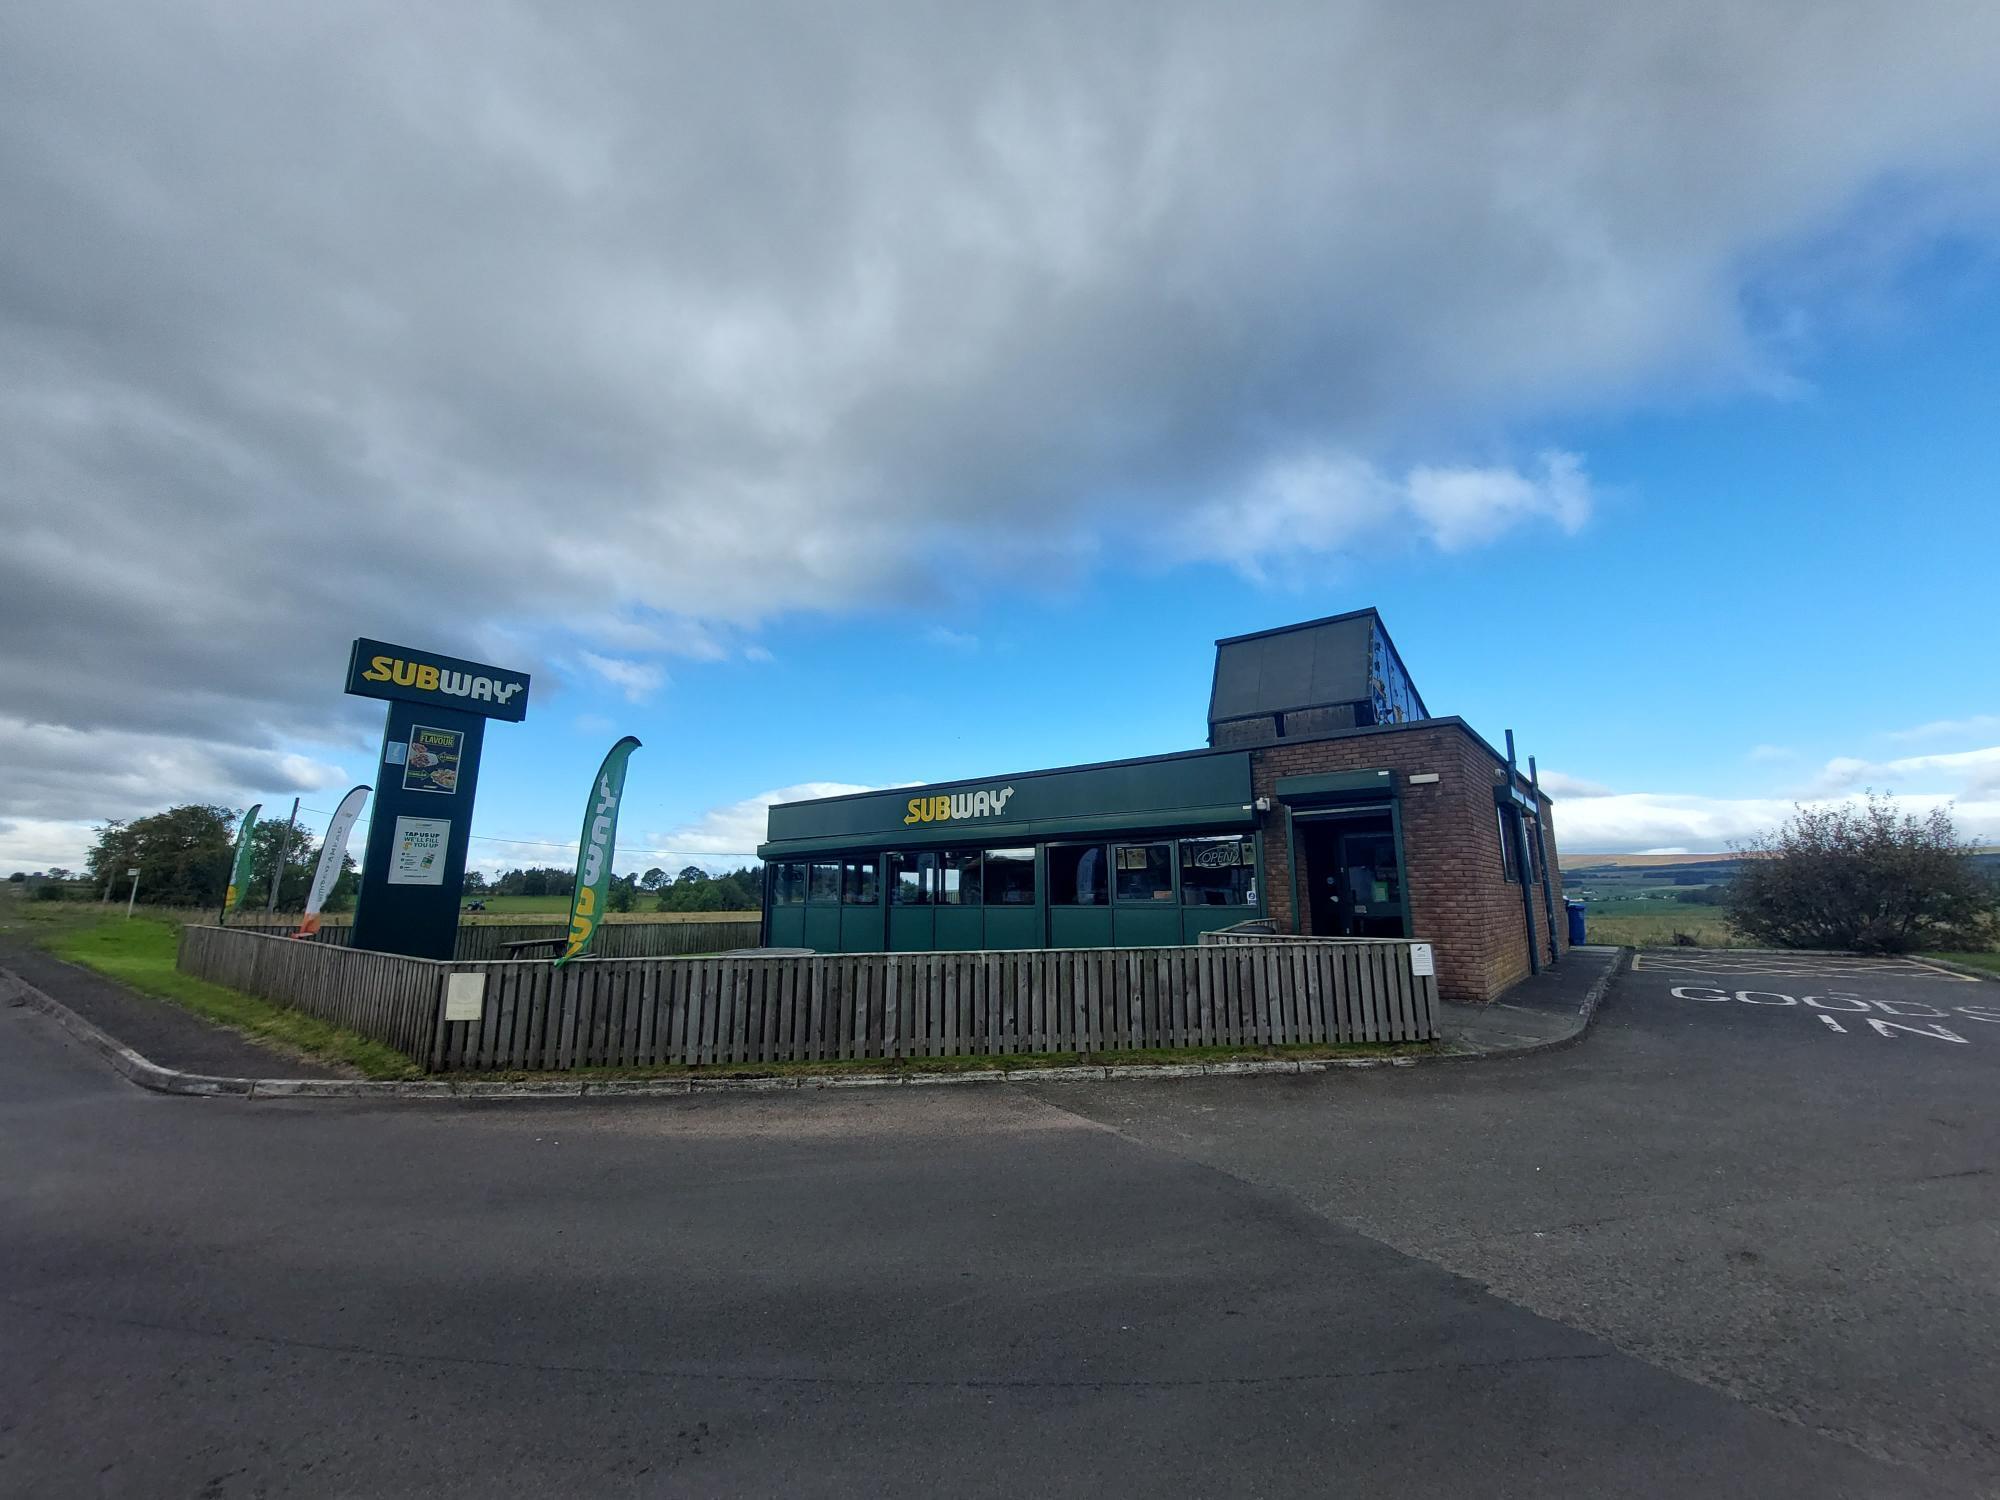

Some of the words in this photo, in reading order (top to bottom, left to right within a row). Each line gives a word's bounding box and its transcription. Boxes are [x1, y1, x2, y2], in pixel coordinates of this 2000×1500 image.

[362, 656, 523, 704] SUBWAY
[420, 735, 454, 747] FLAVOUR
[904, 786, 1015, 825] SUBWAY
[1202, 851, 1234, 863] OPEN
[1817, 1014, 1971, 1043] IN
